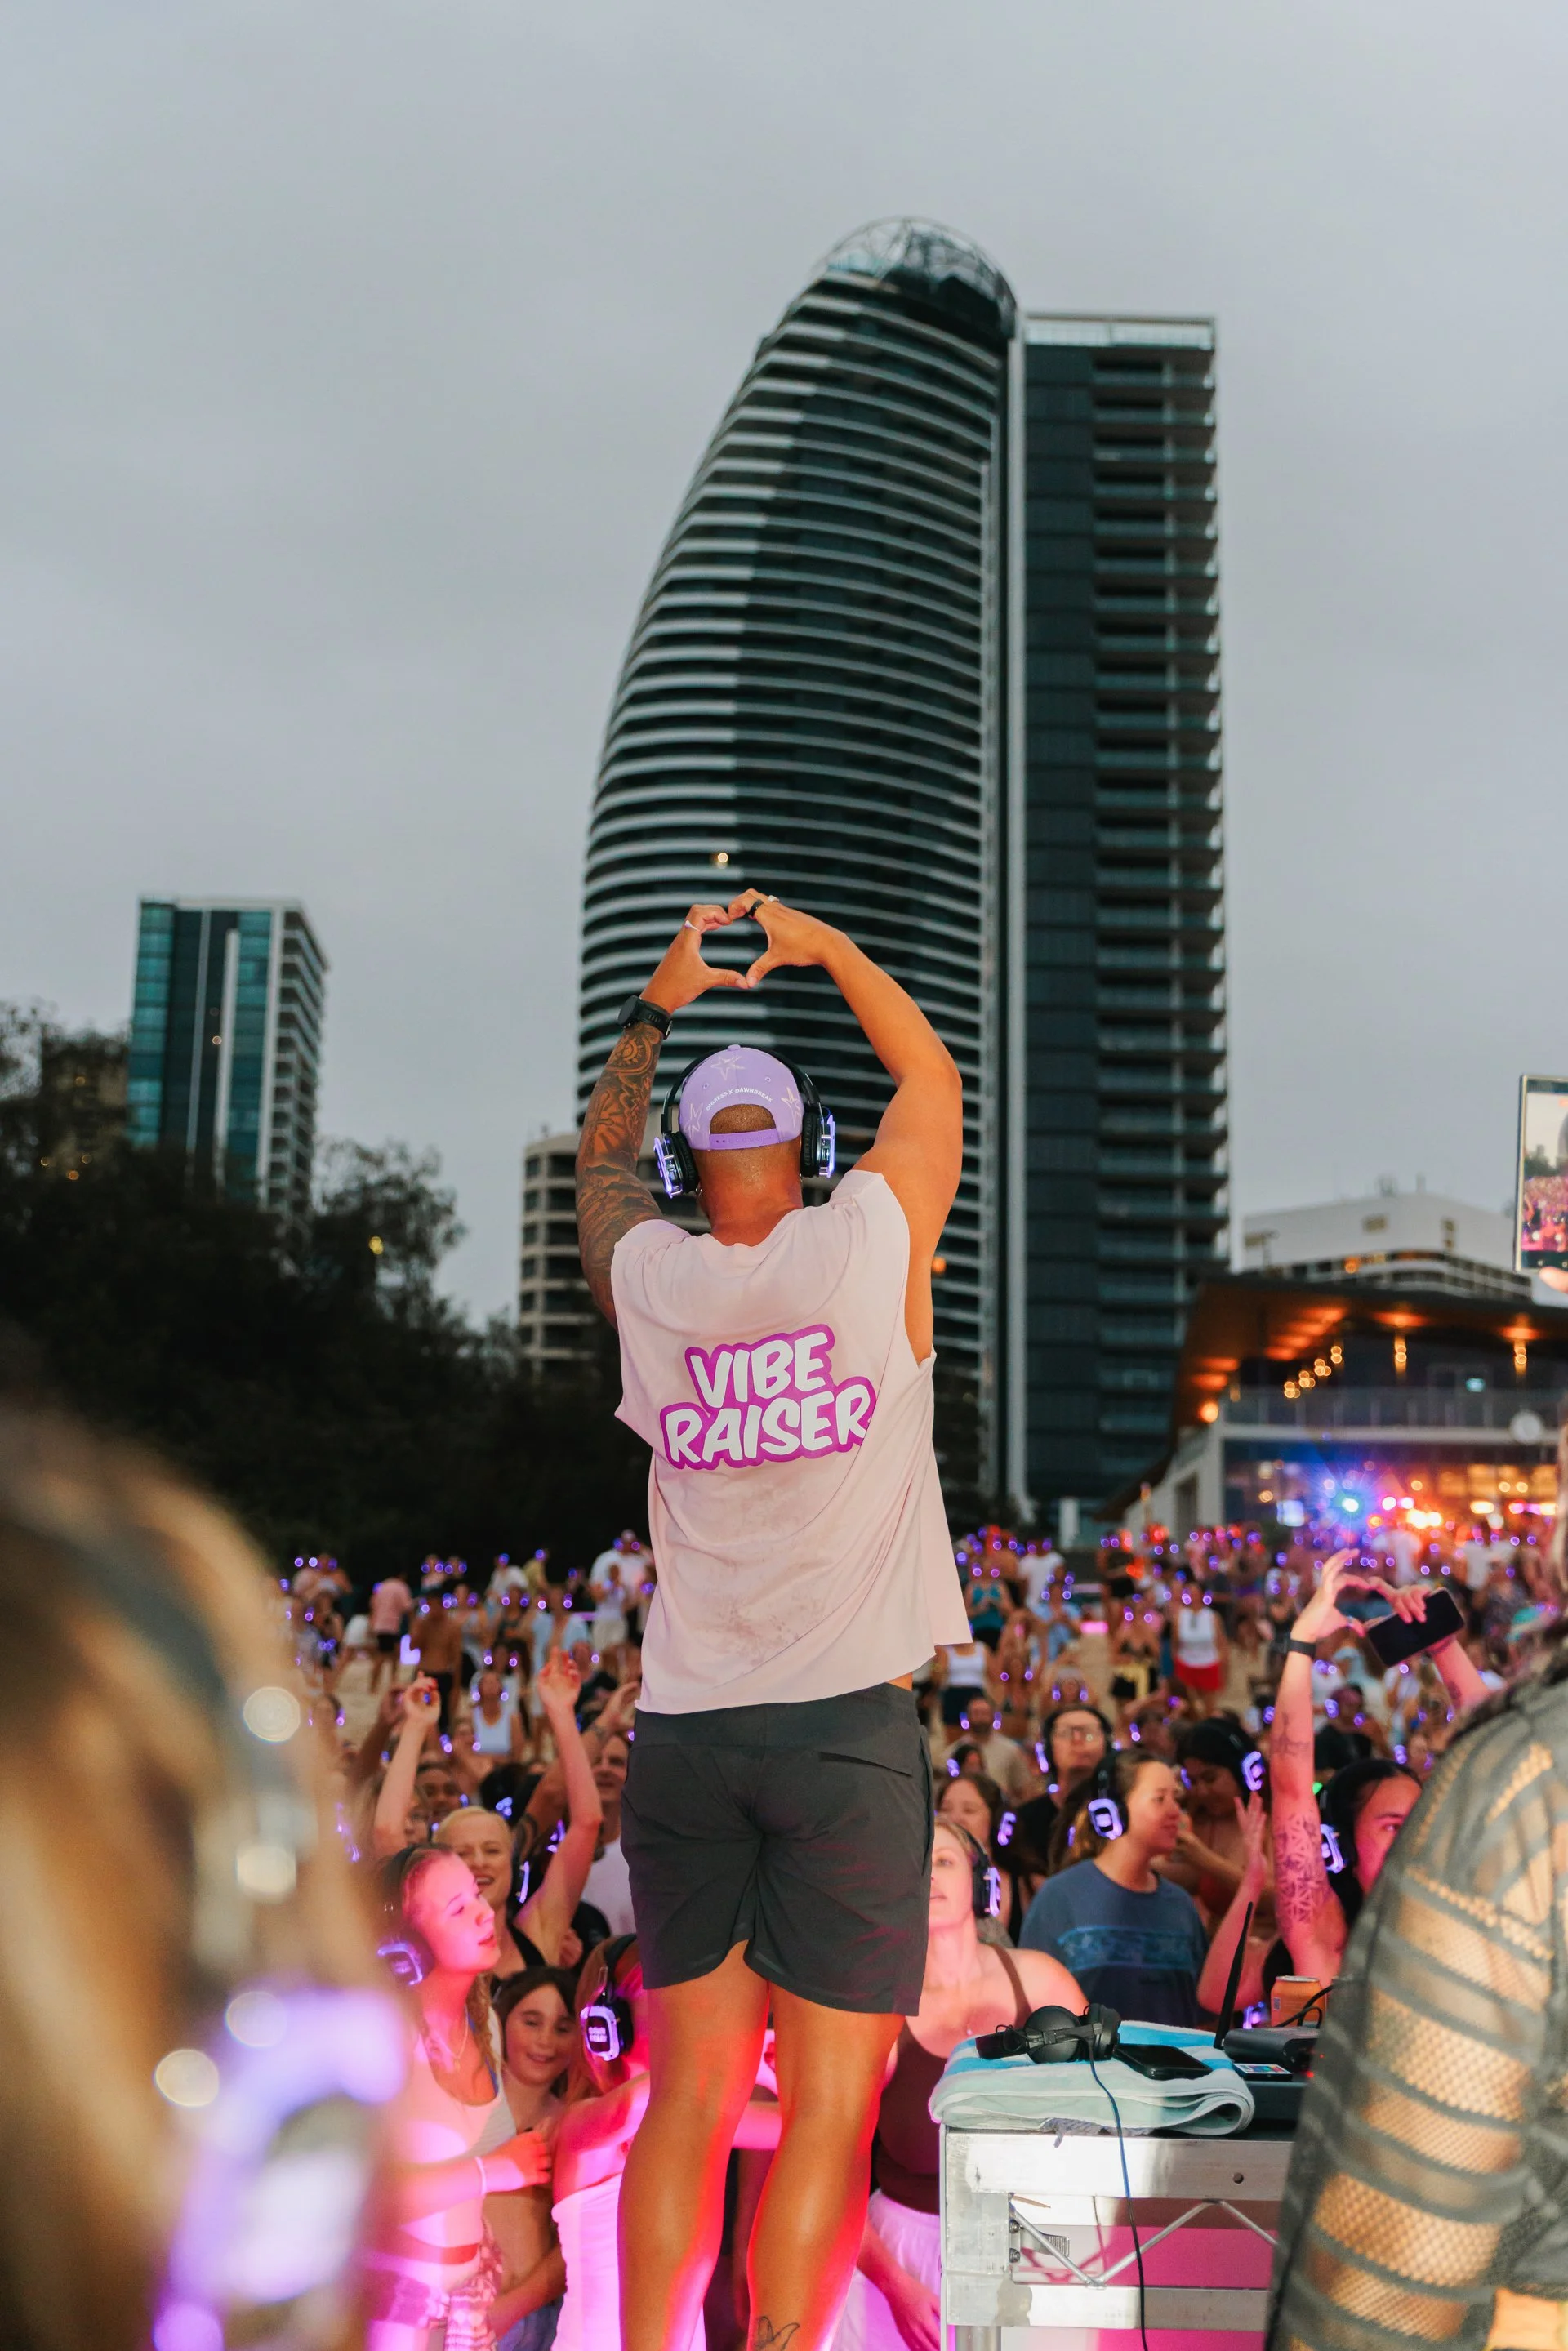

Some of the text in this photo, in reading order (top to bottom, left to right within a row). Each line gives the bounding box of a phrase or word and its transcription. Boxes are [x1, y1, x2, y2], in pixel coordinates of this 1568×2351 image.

[735, 1087, 773, 1102] DAWNBREAK
[689, 1331, 829, 1408] VIBE
[665, 1383, 871, 1463] RAISER
